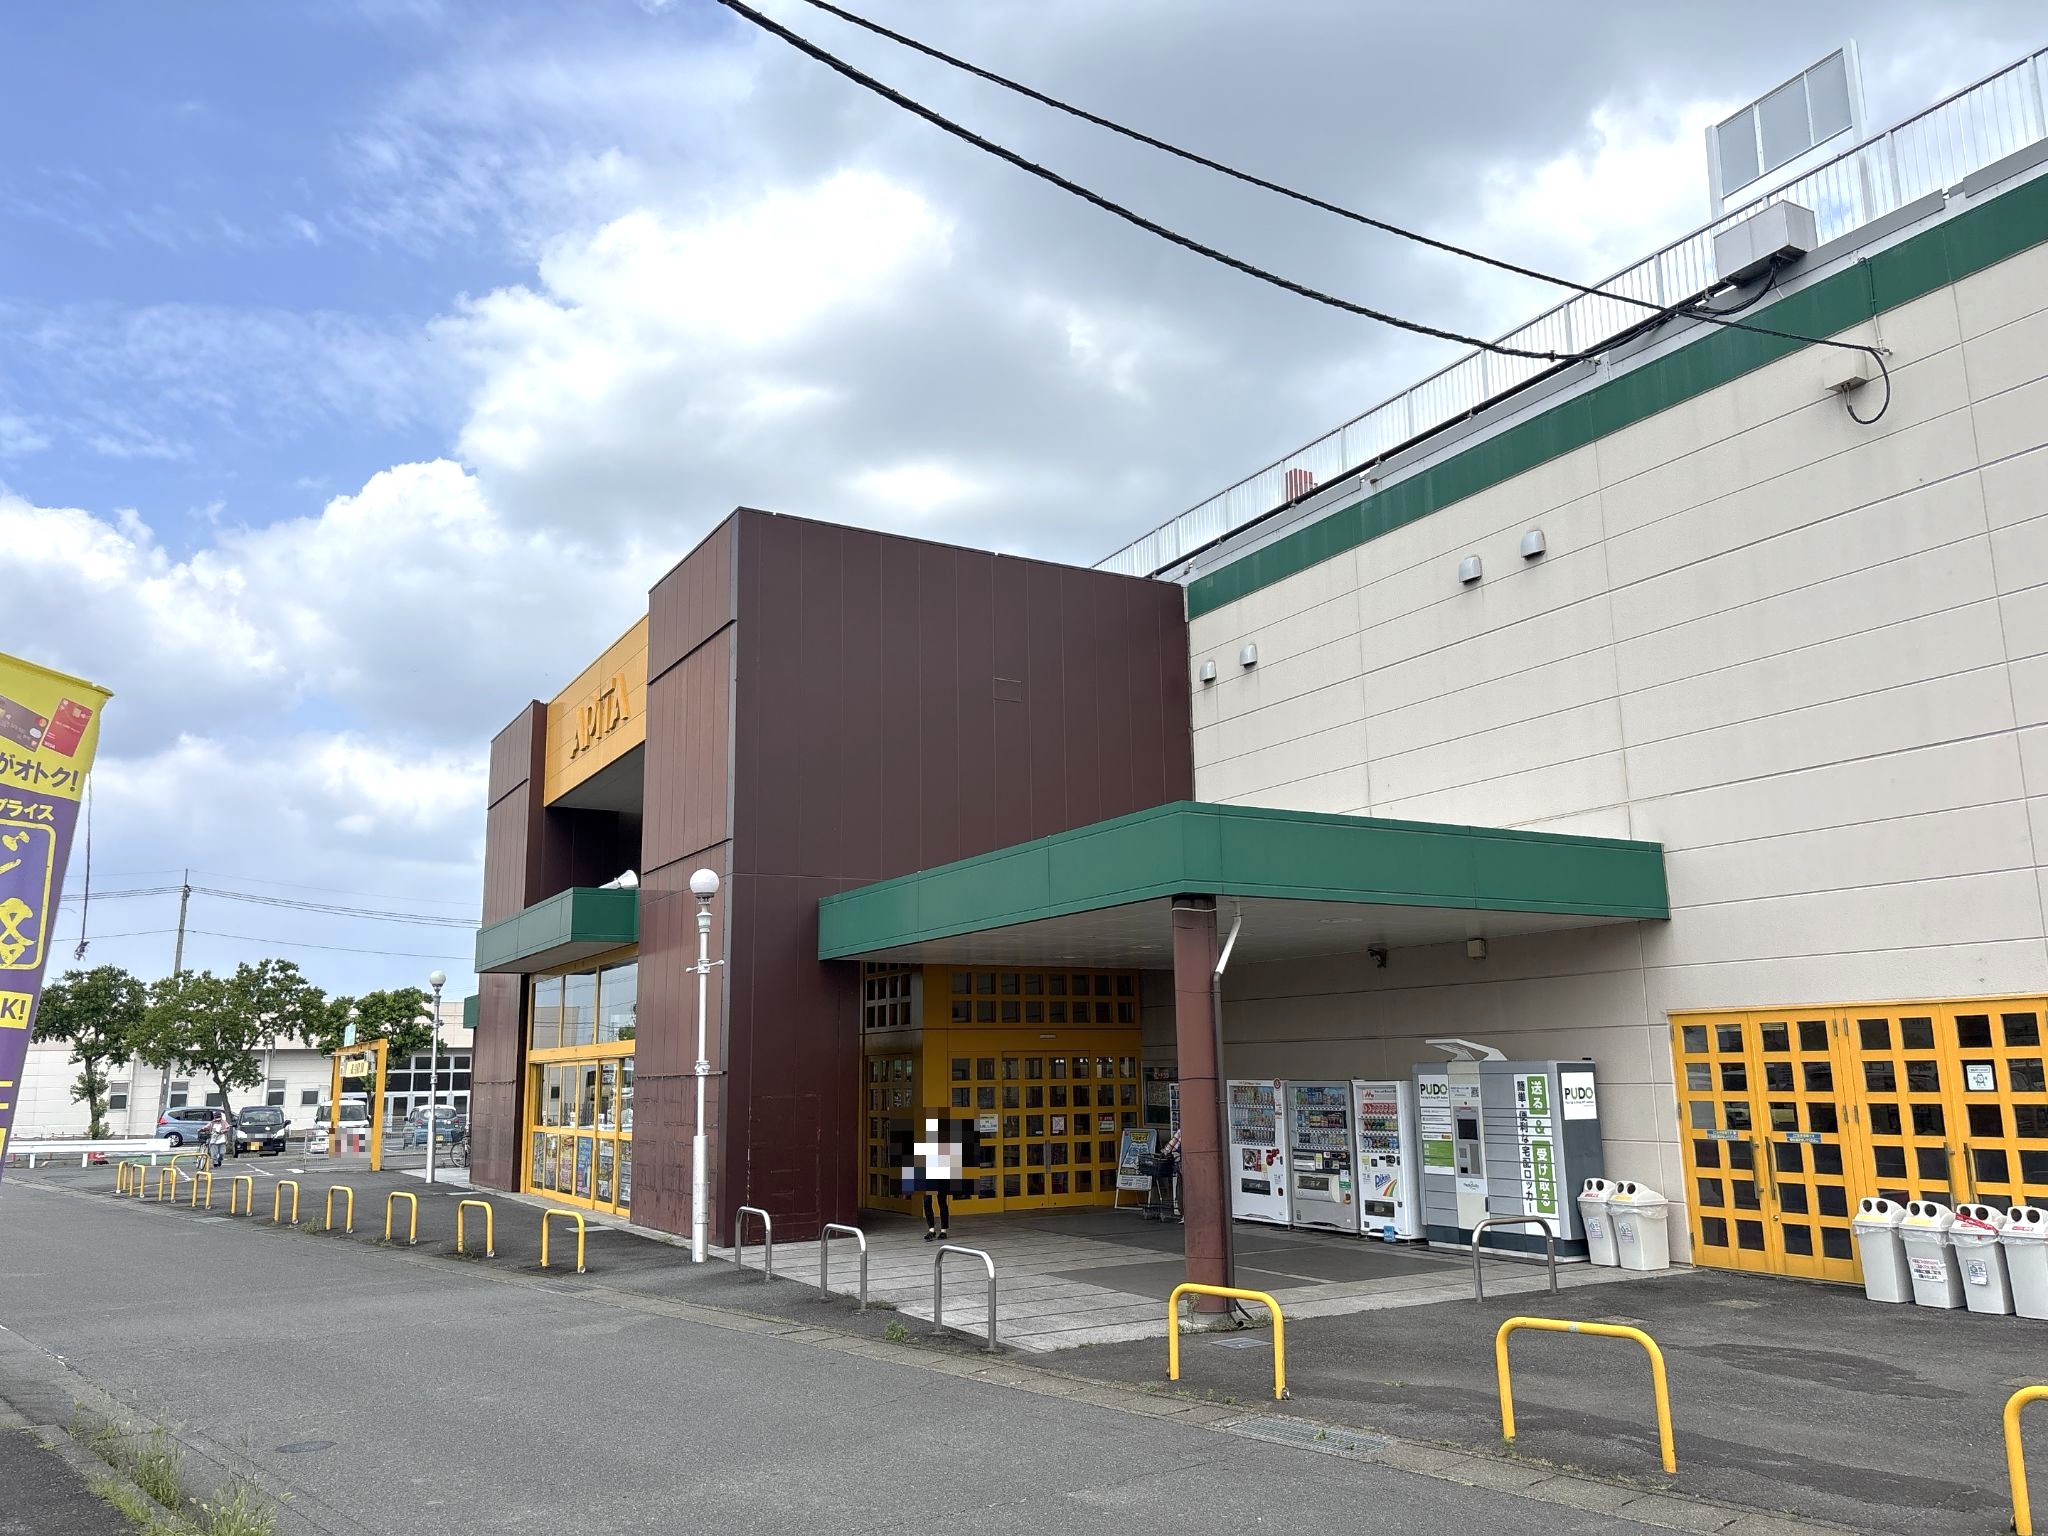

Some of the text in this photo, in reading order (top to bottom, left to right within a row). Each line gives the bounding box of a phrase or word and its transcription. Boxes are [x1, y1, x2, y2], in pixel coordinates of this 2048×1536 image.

[570, 672, 631, 759] APITA
[1420, 1084, 1448, 1095] PUDO
[1564, 1087, 1593, 1099] PUDO
[1530, 1080, 1551, 1207] 送る & 受け取る
